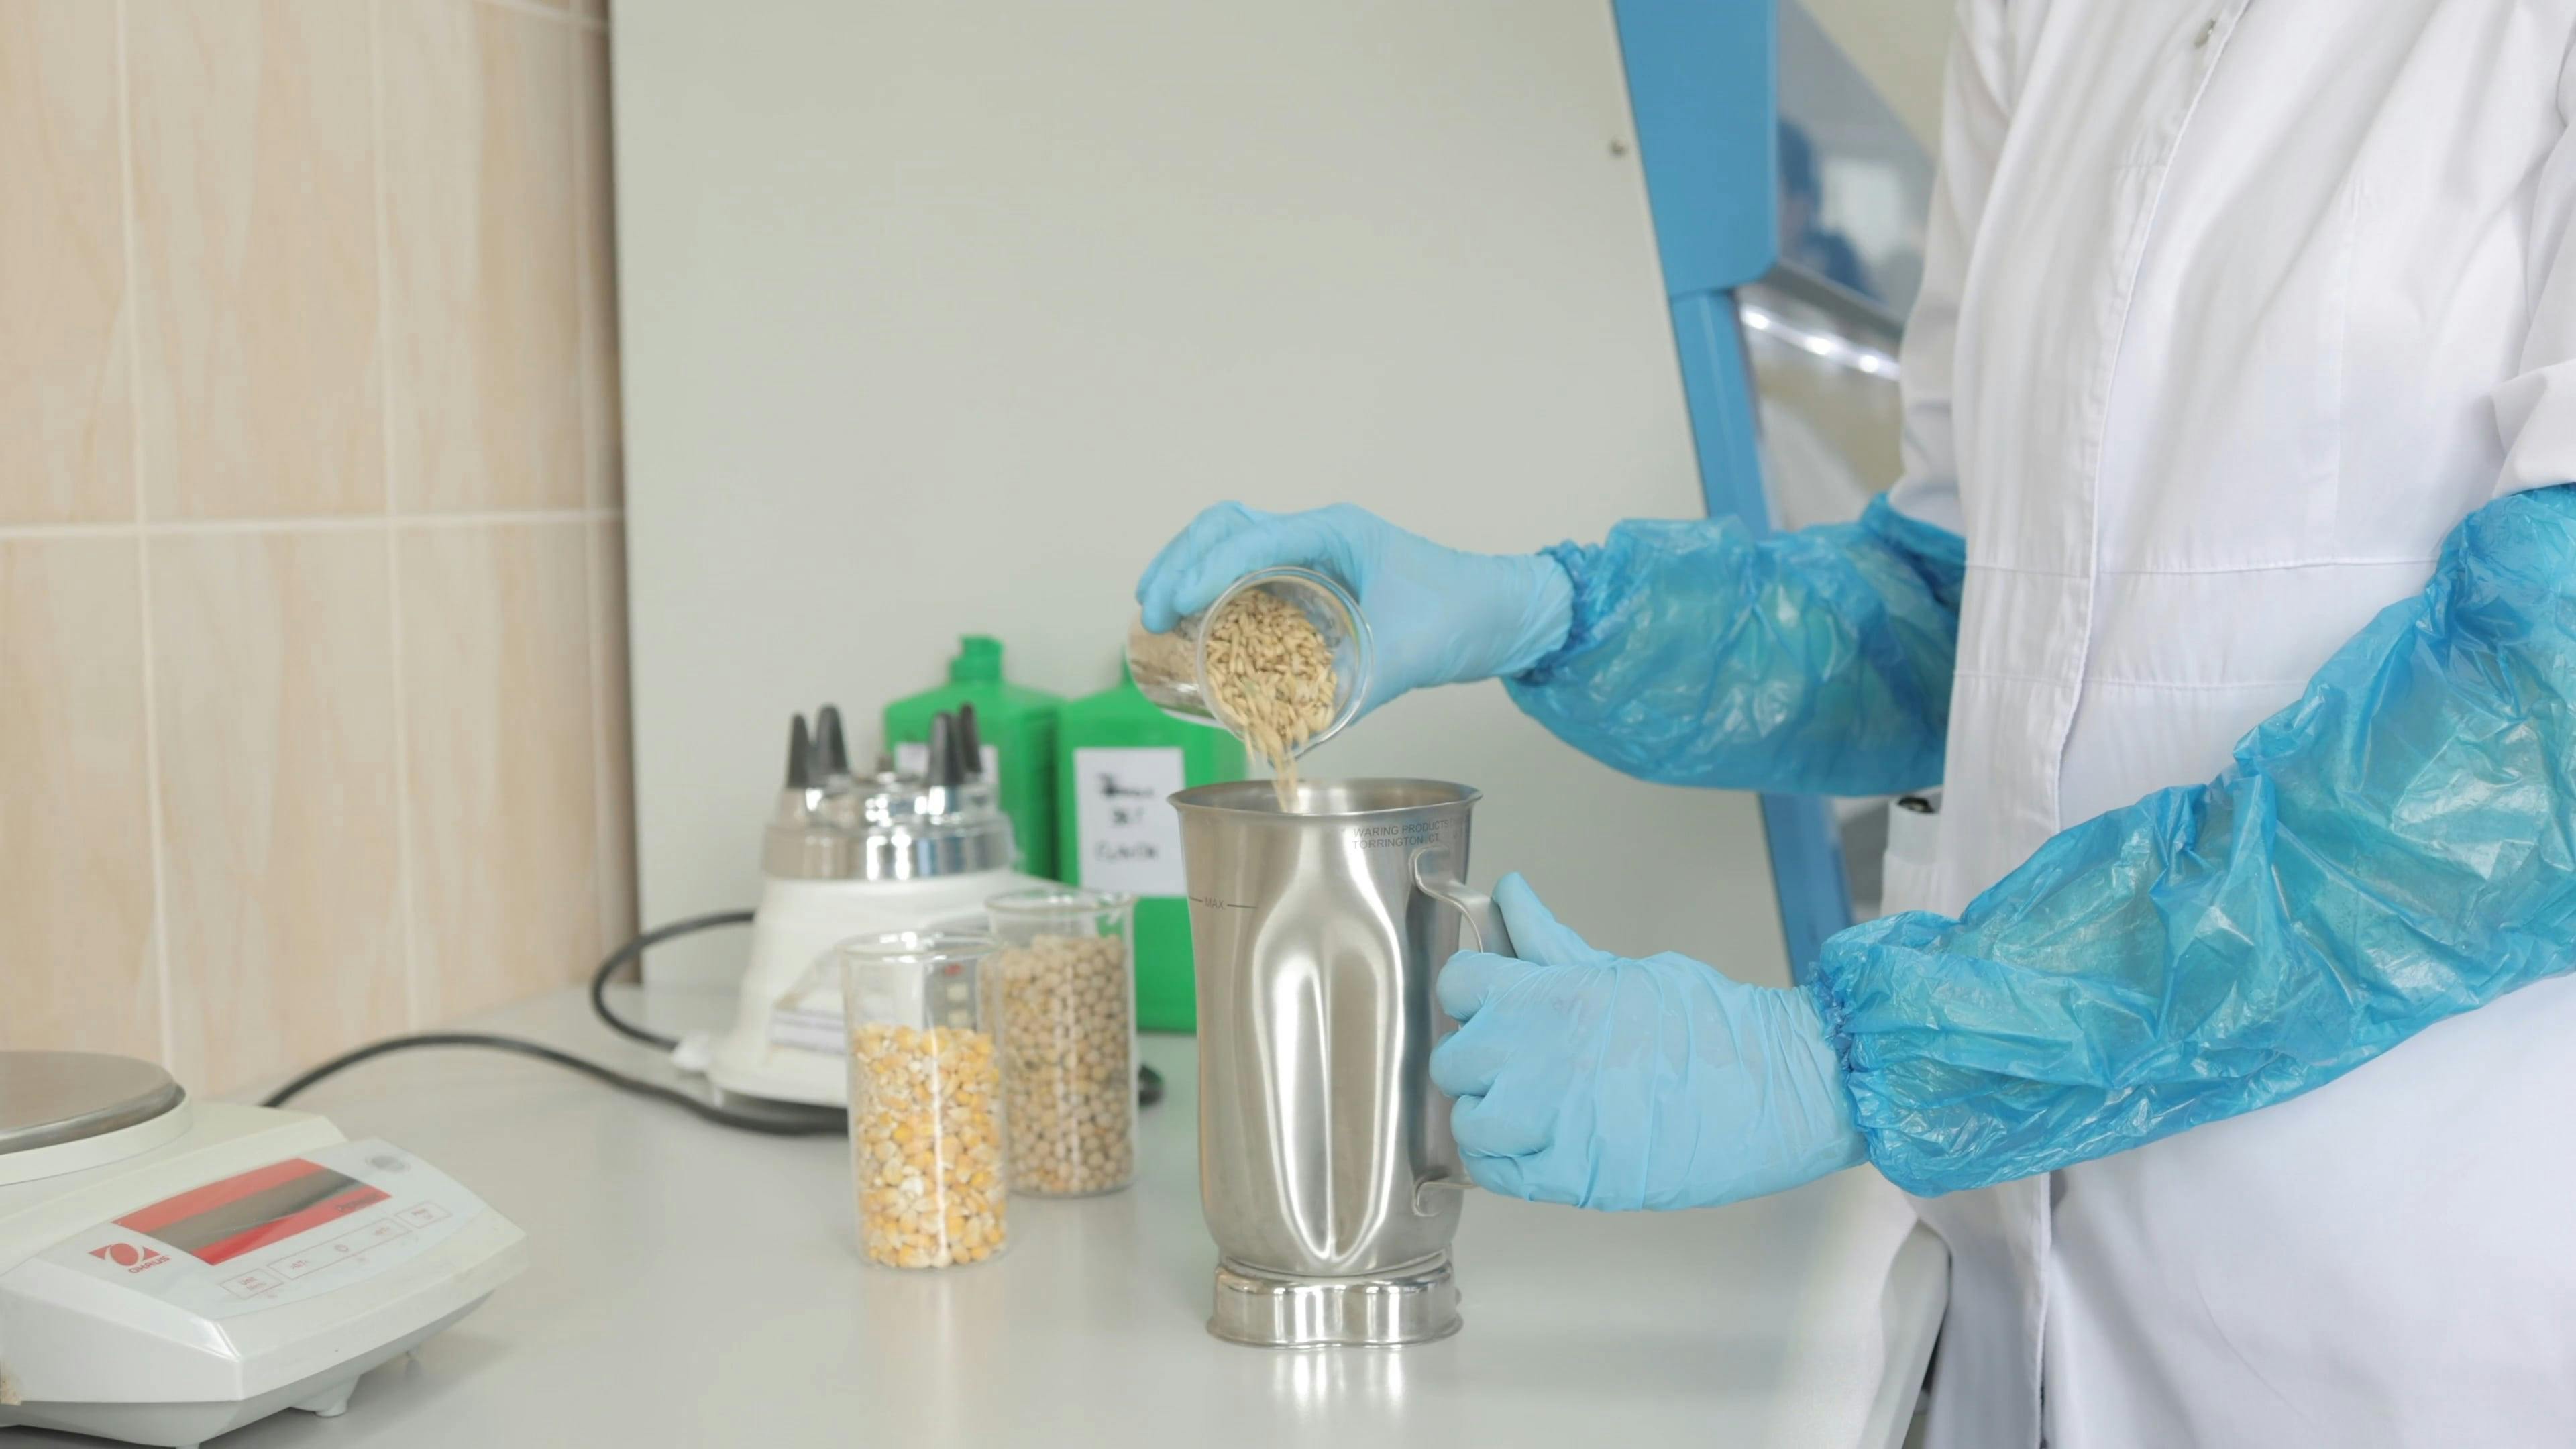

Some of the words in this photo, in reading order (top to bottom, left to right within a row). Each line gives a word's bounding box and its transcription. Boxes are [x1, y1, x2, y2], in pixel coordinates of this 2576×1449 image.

[1353, 825, 1399, 837] WARING
[1401, 820, 1449, 834] PRODUCTS
[1205, 896, 1224, 910] MAX
[128, 1255, 170, 1273] OHAUS
